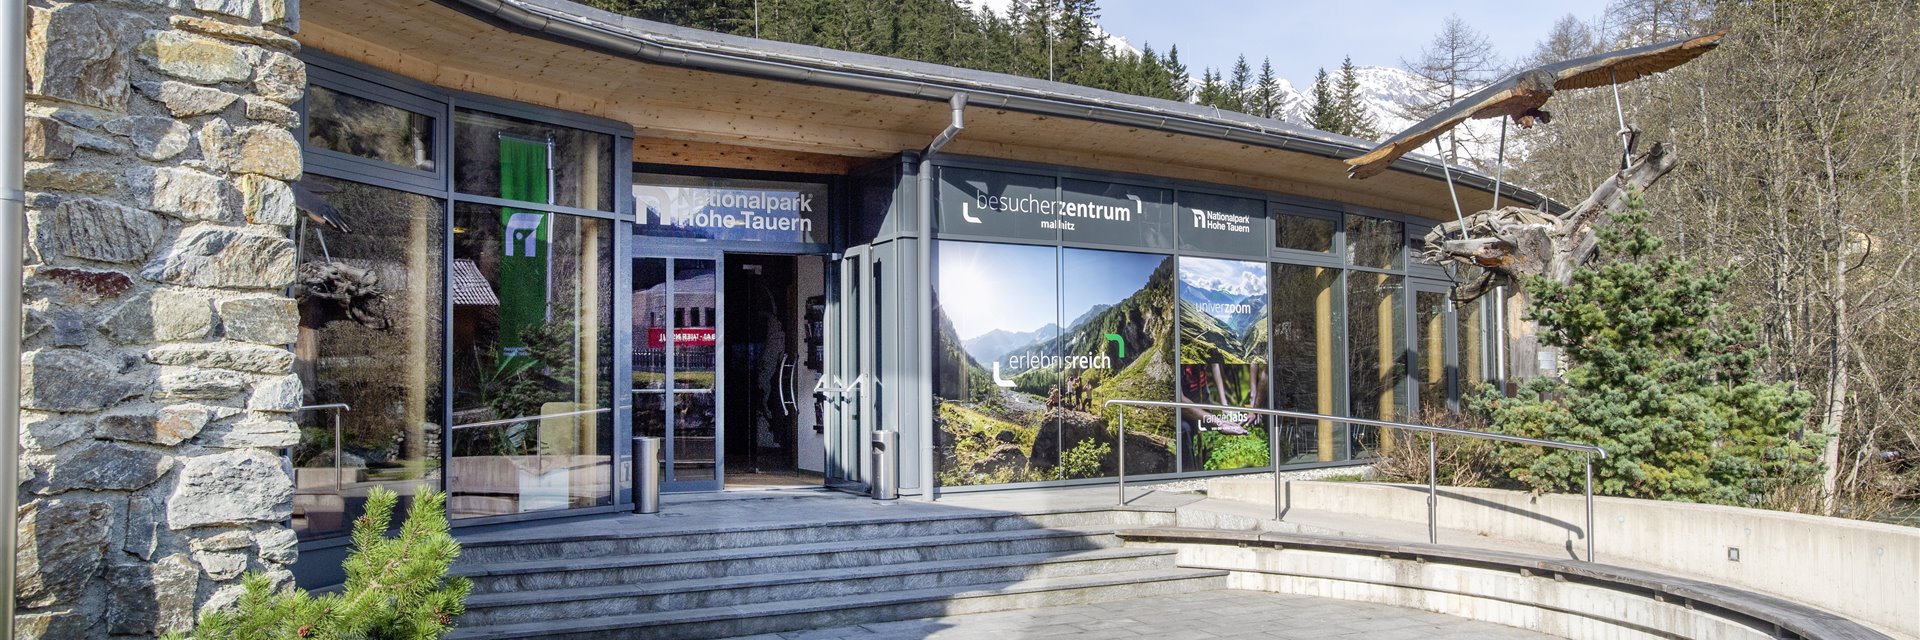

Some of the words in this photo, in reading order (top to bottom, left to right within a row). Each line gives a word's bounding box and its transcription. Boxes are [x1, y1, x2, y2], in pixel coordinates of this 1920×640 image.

[976, 189, 1131, 221] besucherzentrum
[677, 209, 736, 228] Hohe
[741, 211, 812, 231] Tauern
[1207, 211, 1250, 224] Nationalpark
[1207, 221, 1225, 230] Hohe
[1227, 222, 1250, 232] Tauern
[1195, 302, 1251, 314] univerzoom
[1203, 411, 1248, 426] rangerlabs
